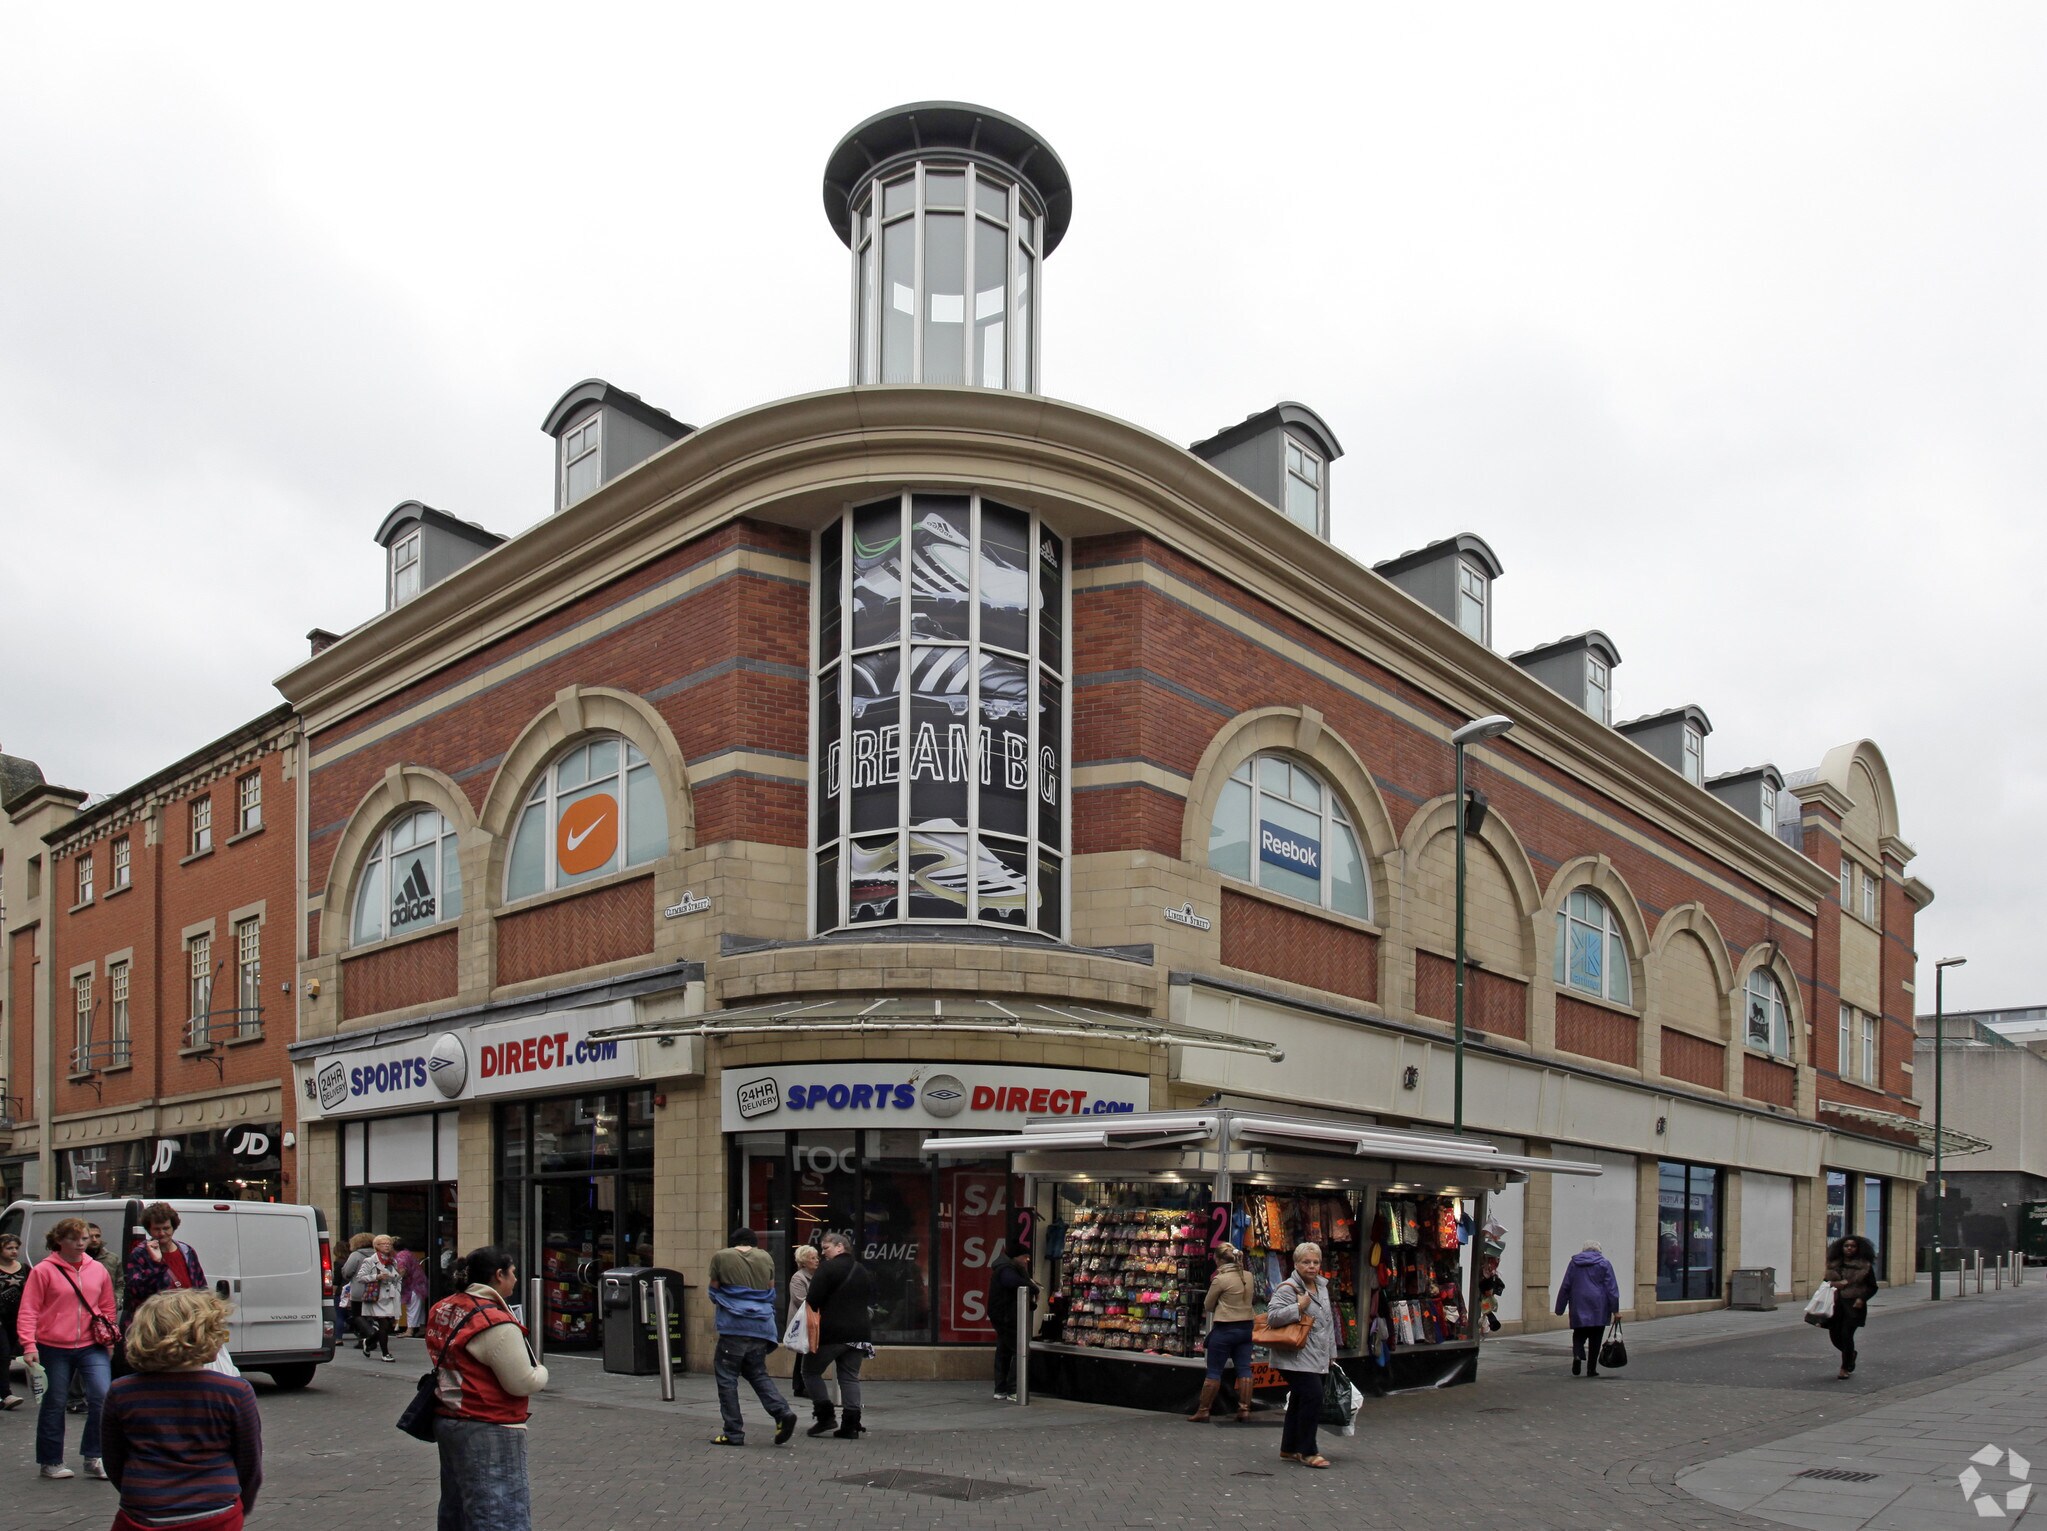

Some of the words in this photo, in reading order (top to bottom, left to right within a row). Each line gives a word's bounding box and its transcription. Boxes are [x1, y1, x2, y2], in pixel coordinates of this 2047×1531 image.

[827, 721, 991, 799] DREAM
[1003, 730, 1056, 806] BG
[1262, 829, 1318, 868] Reebok
[390, 896, 436, 927] adidas
[1190, 915, 1209, 929] STREET
[350, 1056, 428, 1096] SPORTS
[480, 1031, 618, 1079] DIRECT.COM
[321, 1068, 343, 1092] 24HR
[322, 1082, 347, 1102] DELIVERY
[741, 1083, 774, 1103] 24HR
[741, 1095, 777, 1112] DELIVERY
[785, 1083, 916, 1110] SPORTS
[970, 1085, 1135, 1115] DIRECT.COM
[151, 1139, 173, 1174] JD
[233, 1132, 270, 1156] JD
[1209, 1206, 1228, 1249] 2
[863, 1242, 919, 1261] GAME
